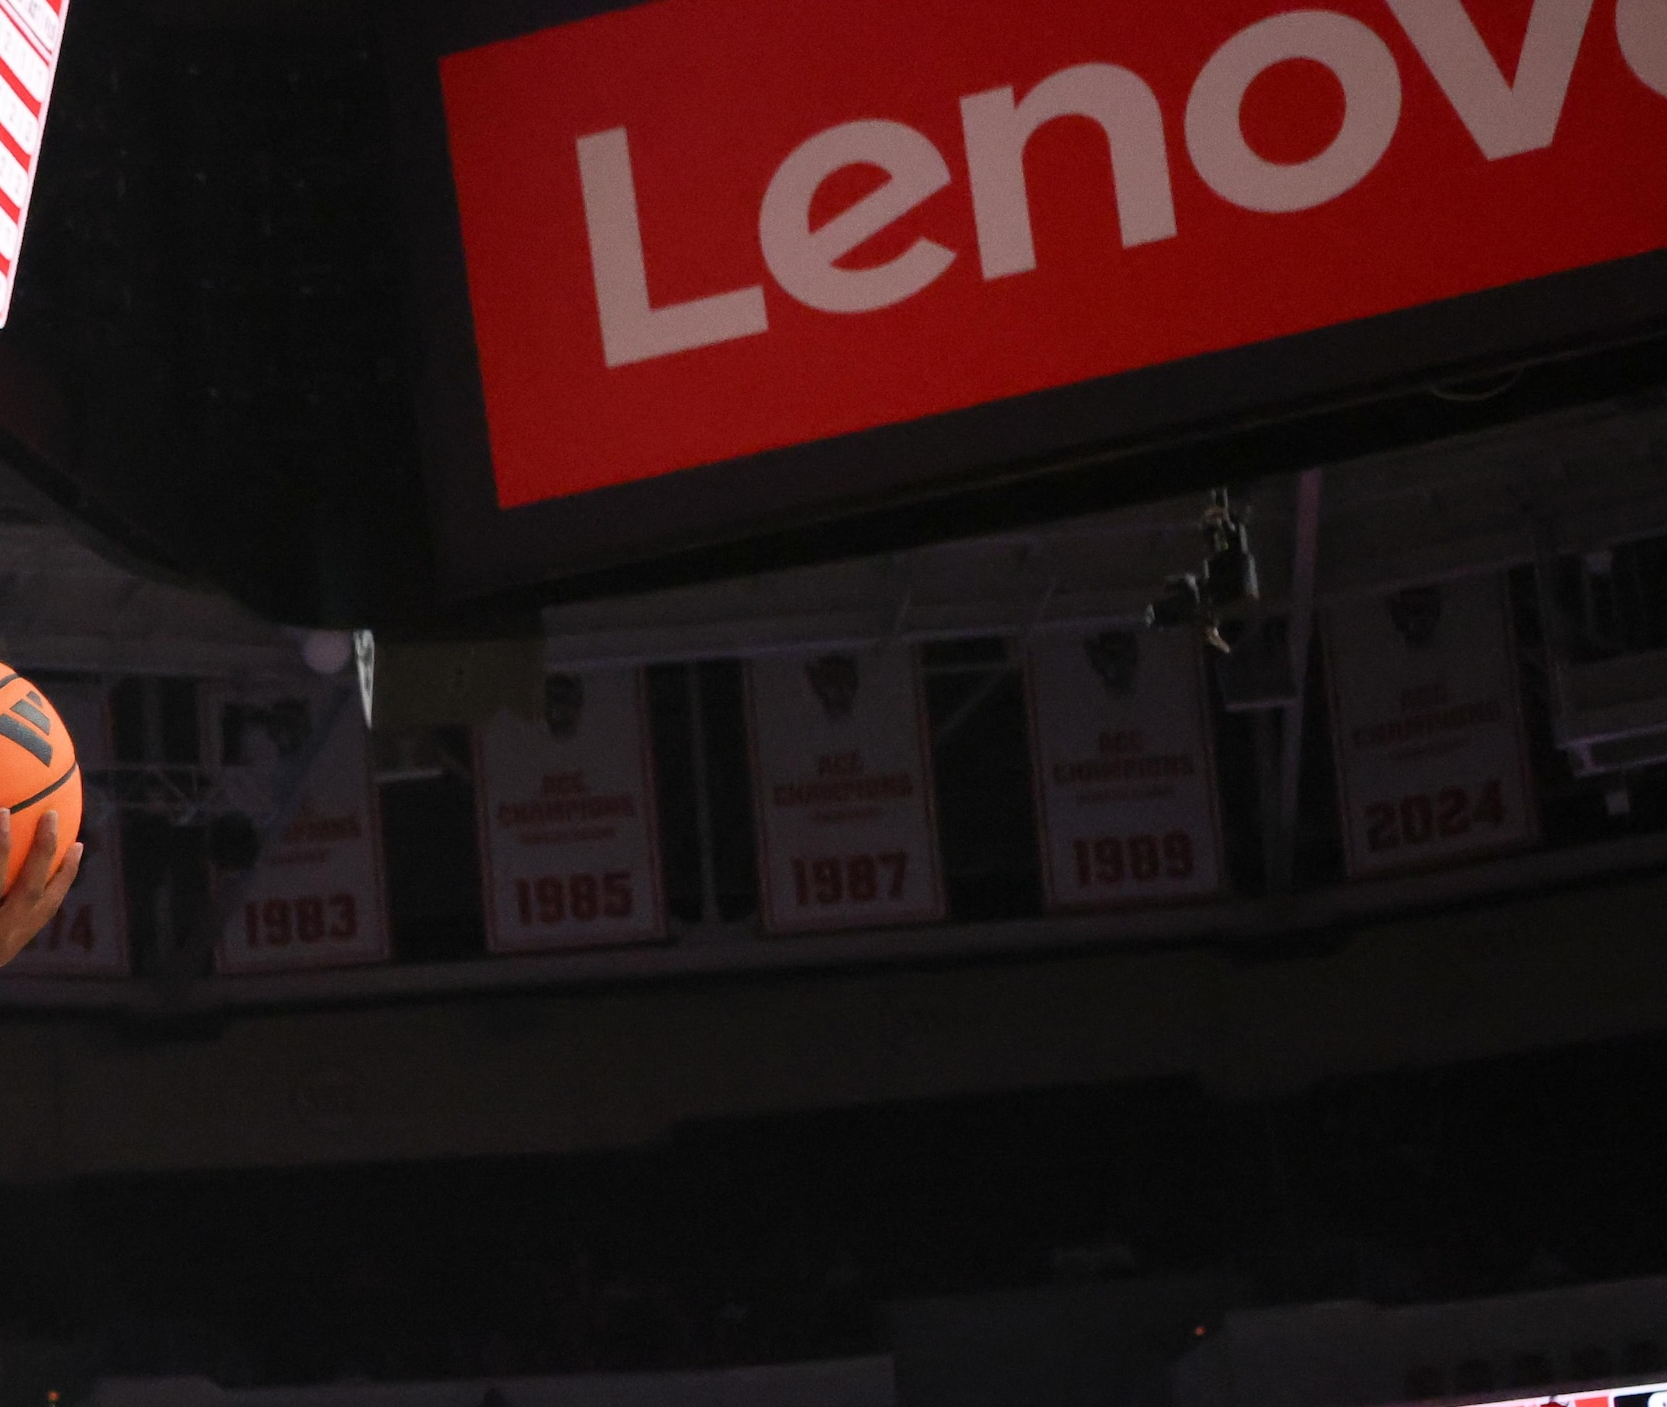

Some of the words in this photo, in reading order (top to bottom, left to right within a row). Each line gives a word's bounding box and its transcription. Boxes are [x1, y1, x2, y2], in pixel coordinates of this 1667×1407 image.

[773, 773, 914, 808] CHAMPIONS
[1053, 755, 1195, 785] CHAMPIONS
[498, 794, 634, 827] CHAMPIONS
[1365, 778, 1505, 854] 2024
[791, 851, 909, 908] 1987
[1073, 830, 1195, 888] 1989
[245, 893, 358, 948] 1983
[515, 871, 634, 926] 1985
